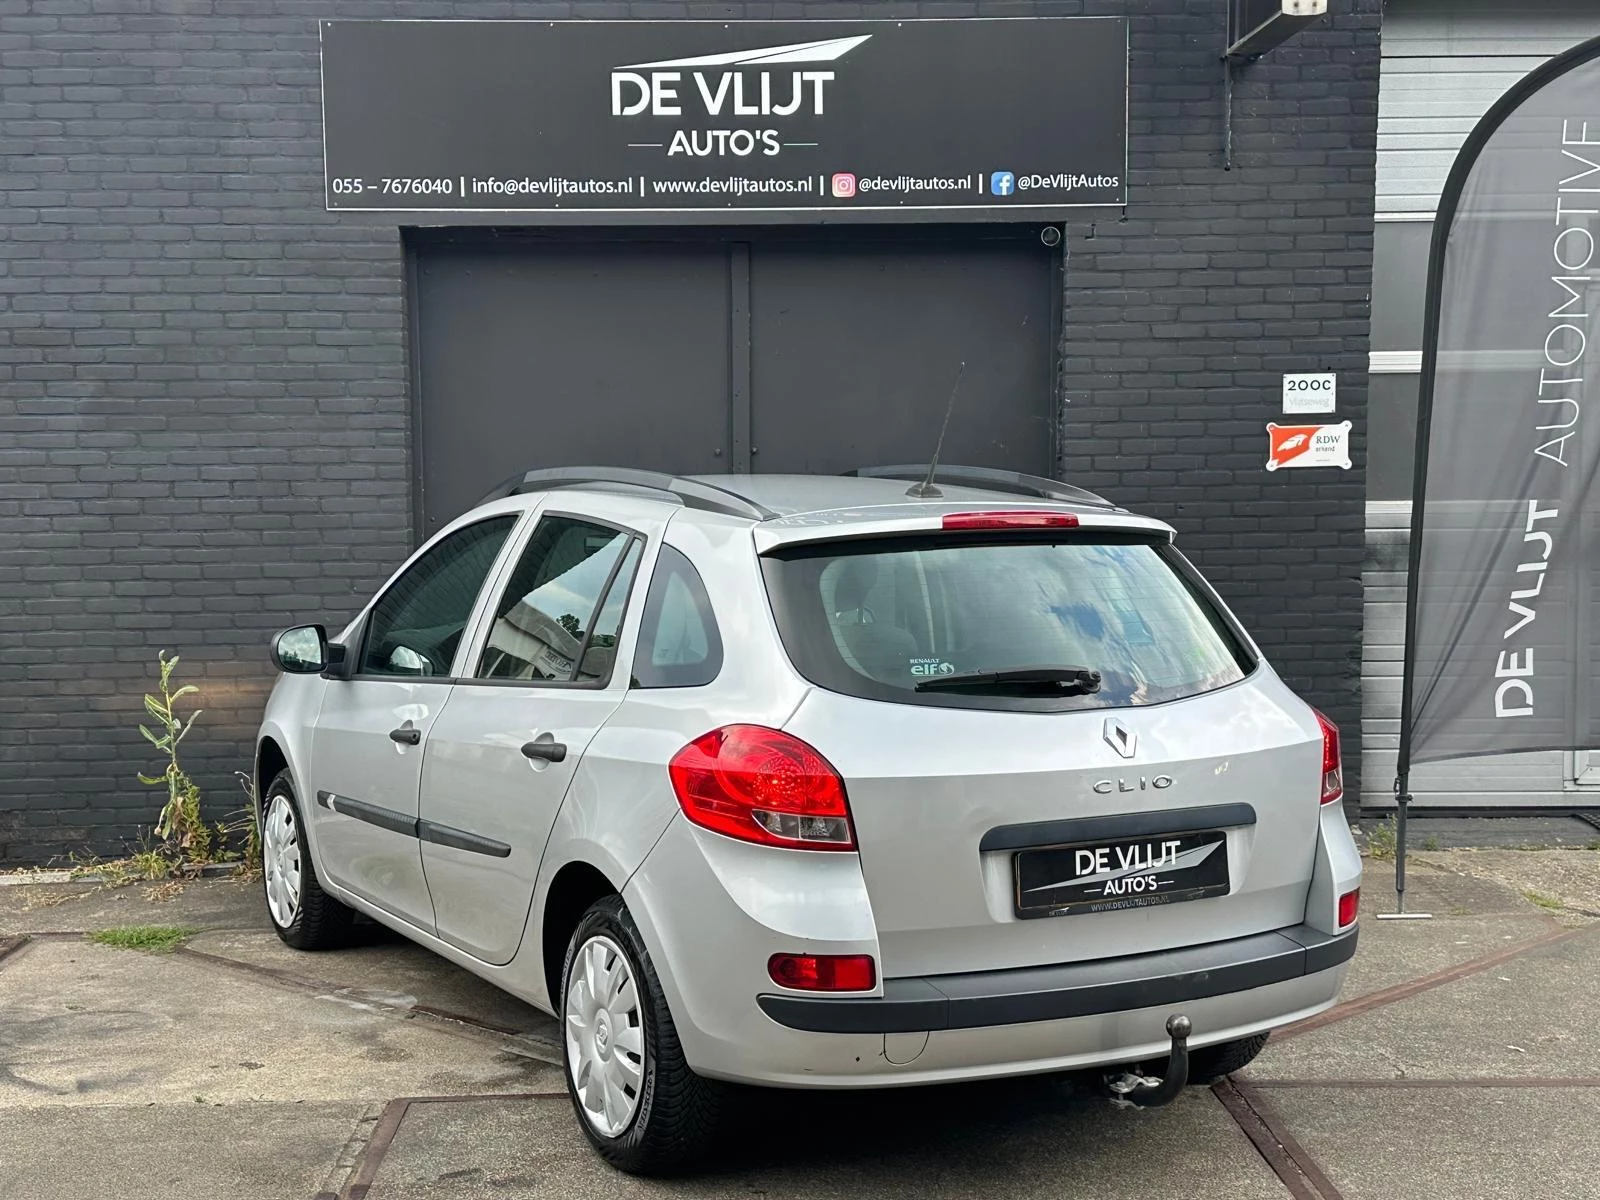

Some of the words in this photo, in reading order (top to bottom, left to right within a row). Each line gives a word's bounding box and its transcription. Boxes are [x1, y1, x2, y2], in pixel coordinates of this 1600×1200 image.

[611, 72, 682, 116] DE
[693, 71, 835, 116] VLIJT
[667, 129, 781, 157] AUTO'S
[332, 178, 363, 194] 055
[381, 178, 453, 195] 7676040
[472, 176, 633, 198] info@devlijtautos.nl
[652, 175, 813, 197] www.devlijtautos.nl
[858, 174, 971, 194] @devlijtautos.nl
[1017, 173, 1119, 192] @DeVlijtAutos
[1534, 119, 1600, 467] AUTOMOTIVE
[1287, 379, 1331, 391] 200C
[1315, 435, 1341, 444] RDW
[1503, 499, 1559, 640] VLIJT
[1494, 647, 1534, 718] DE
[1093, 774, 1173, 794] CLIO
[1075, 847, 1111, 876] DE
[1115, 840, 1182, 871] VLIJT
[1103, 875, 1158, 896] AUTO'S
